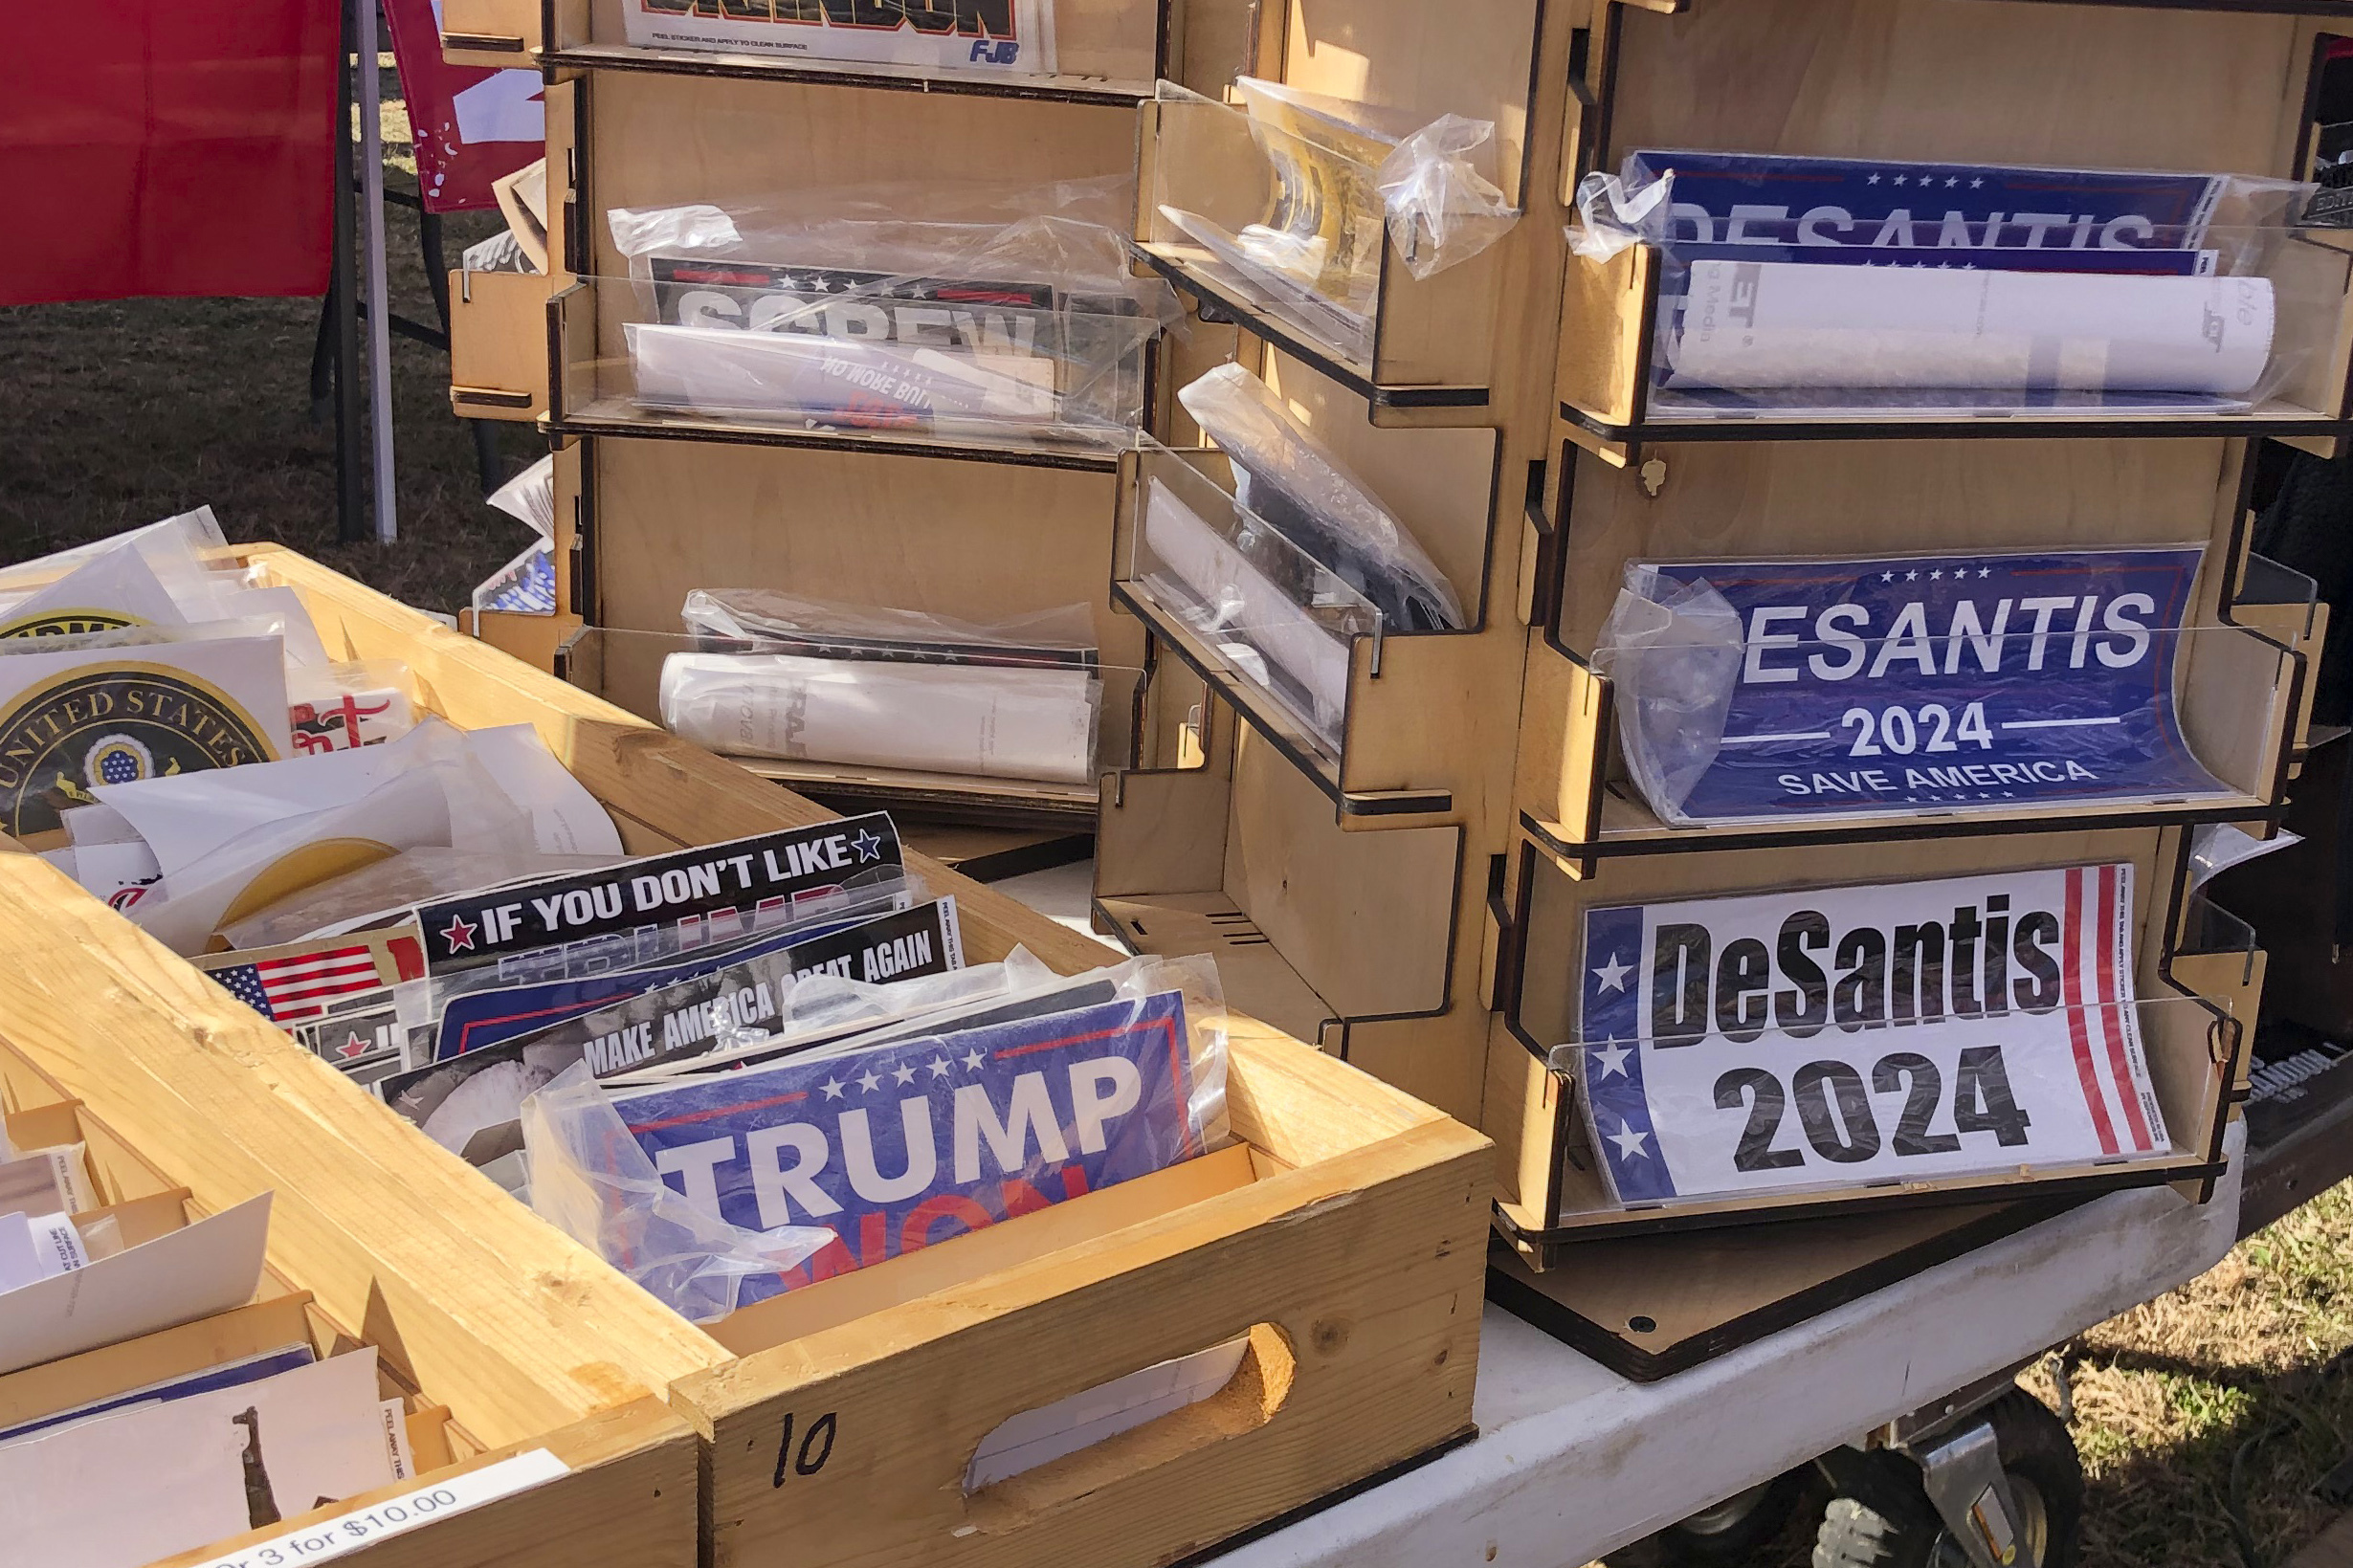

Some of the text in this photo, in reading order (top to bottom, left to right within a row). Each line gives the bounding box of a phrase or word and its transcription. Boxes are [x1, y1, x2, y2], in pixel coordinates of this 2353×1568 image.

[969, 39, 1020, 65] FJB
[1742, 592, 2155, 685] ESANTIS
[0, 691, 115, 789] UNITED
[126, 690, 247, 768] STATES
[1841, 702, 1993, 759] 2024
[1778, 759, 2099, 798] SAVE AMERICA
[481, 834, 853, 945] IF YOU DON'T LIKE
[584, 1023, 655, 1078] MAKE
[862, 930, 933, 983] AGAIN
[1652, 894, 2064, 1050] DeSantis
[655, 1055, 1143, 1229] TRUMP
[1713, 1044, 2031, 1174] 2024
[57, 1155, 68, 1179] PEEL
[62, 1176, 75, 1196] AWAY
[49, 1227, 61, 1245] LINE
[56, 1245, 69, 1260] CUT
[57, 1226, 78, 1260] SURFACE
[384, 1408, 405, 1480] PEEL AWAY THIS
[772, 1411, 838, 1490] 10
[257, 1547, 285, 1567] 3
[289, 1530, 337, 1557] for
[343, 1489, 457, 1537] $10.00
